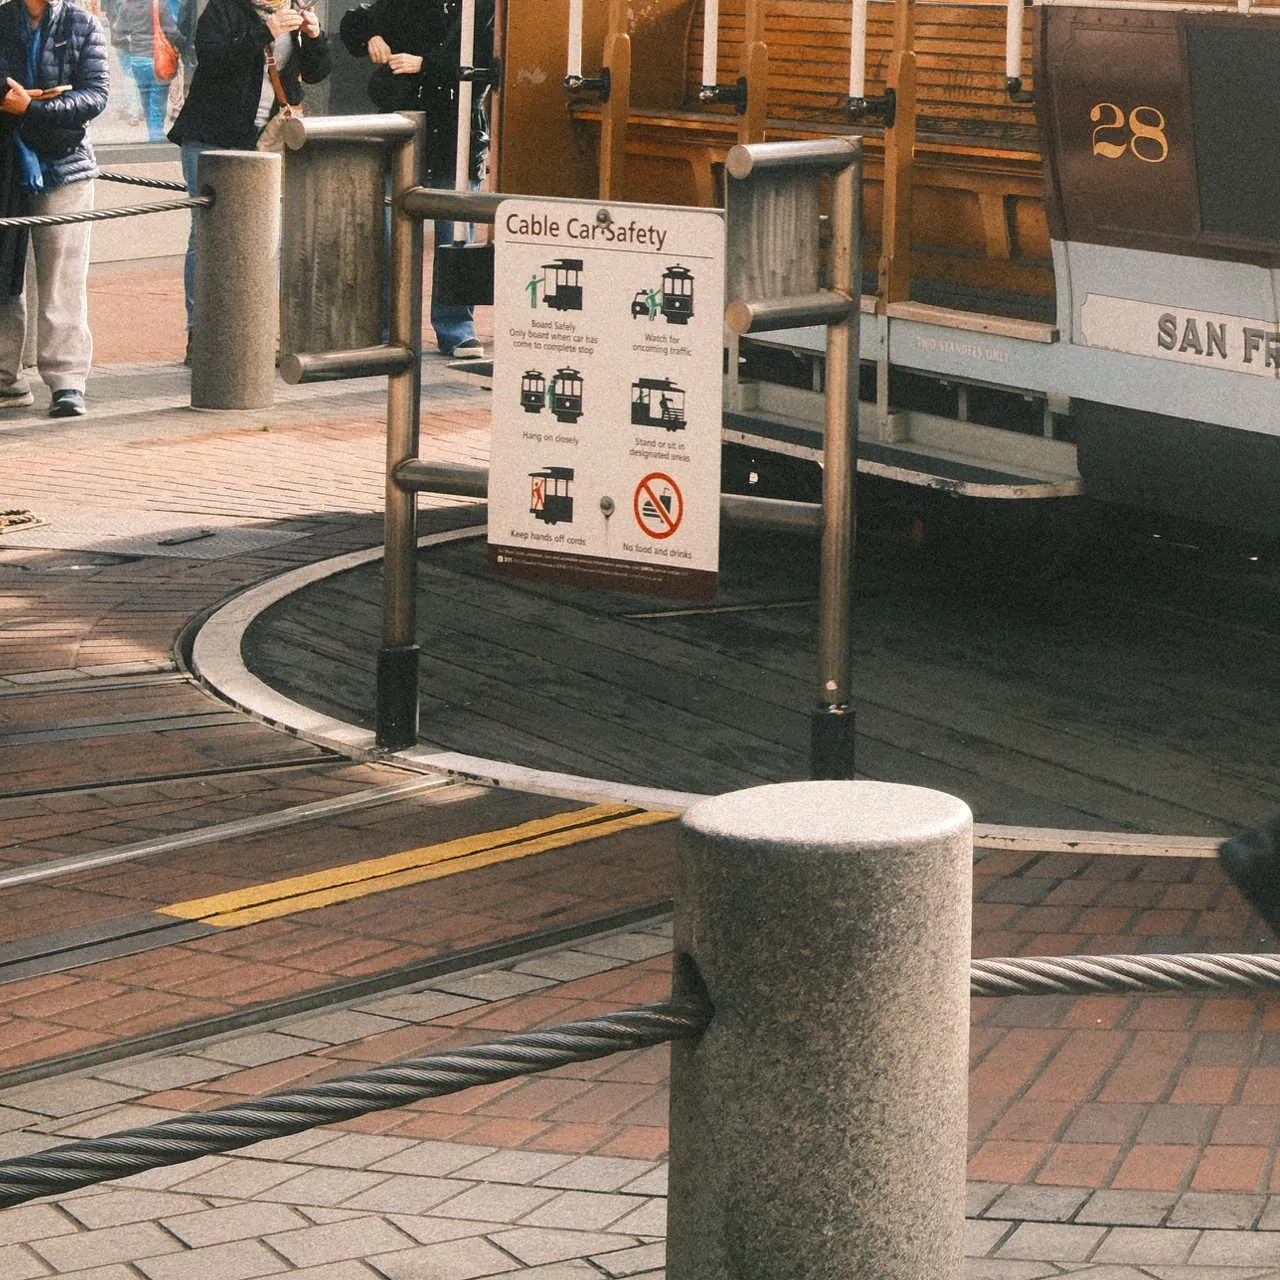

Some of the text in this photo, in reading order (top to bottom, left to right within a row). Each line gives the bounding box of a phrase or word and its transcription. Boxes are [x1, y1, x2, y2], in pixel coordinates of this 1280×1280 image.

[1089, 102, 1169, 163] 28
[506, 213, 667, 251] Cable Car Safety
[1157, 312, 1227, 360] SAN
[510, 530, 529, 542] Keep
[531, 531, 552, 543] hands
[623, 542, 634, 552] No
